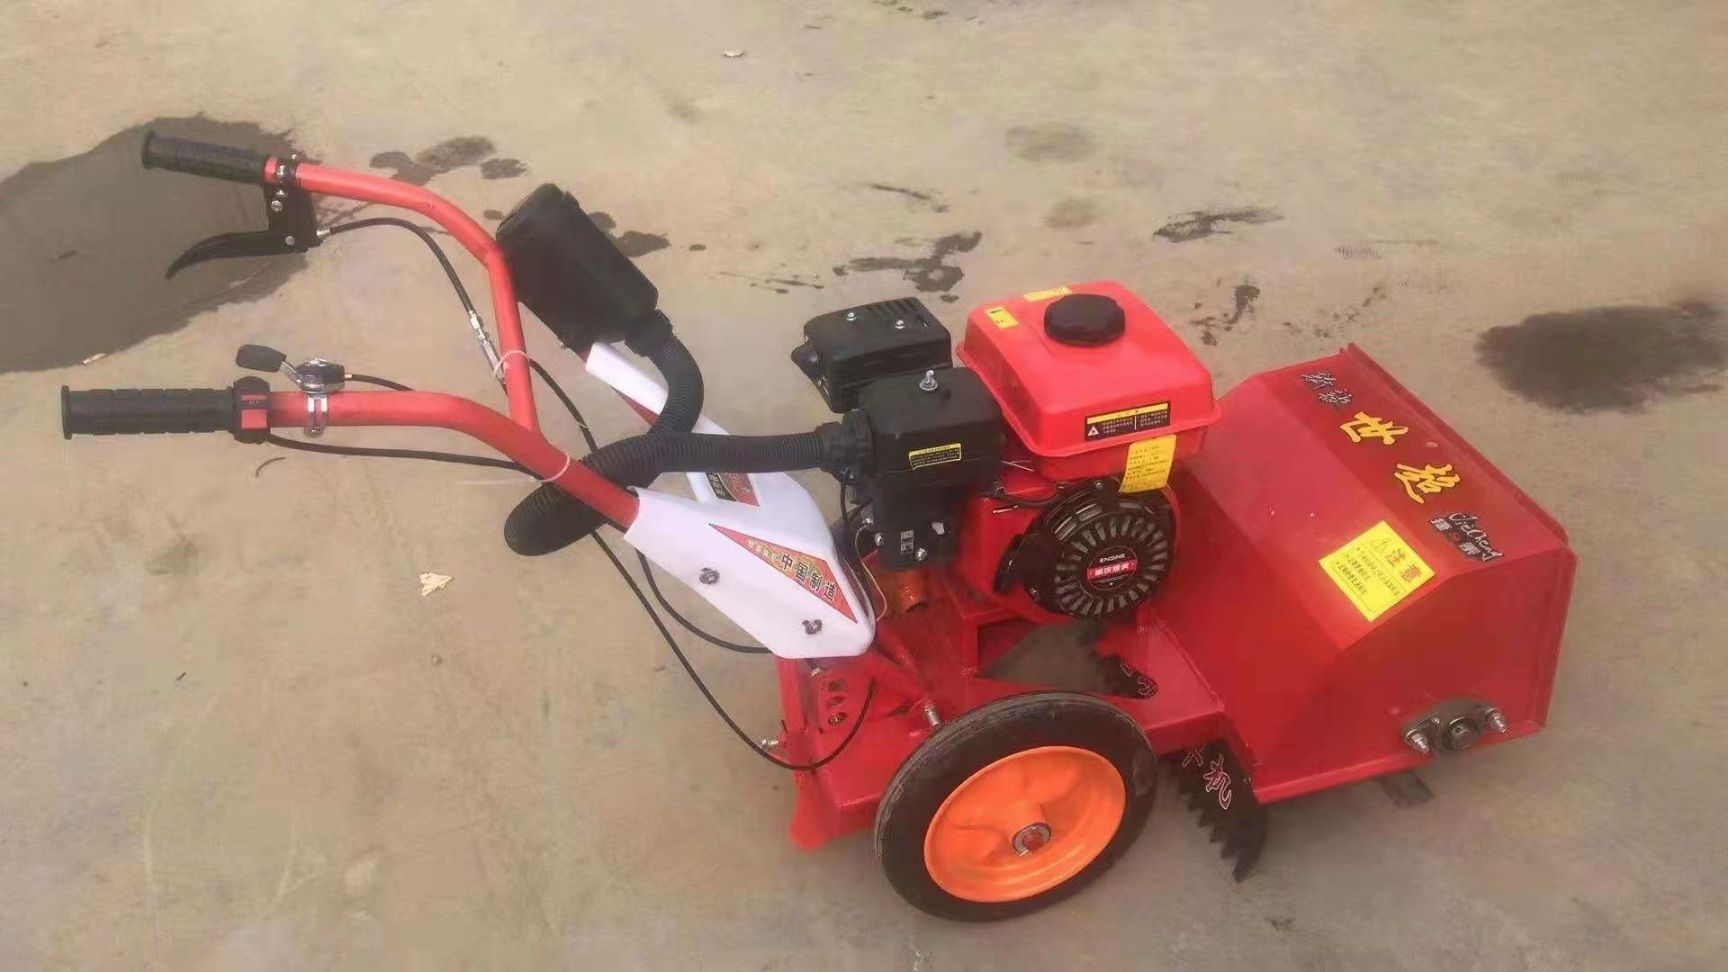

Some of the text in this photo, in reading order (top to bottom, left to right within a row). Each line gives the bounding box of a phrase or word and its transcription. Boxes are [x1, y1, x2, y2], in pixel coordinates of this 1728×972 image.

[781, 551, 837, 602] 中国制造
[1099, 553, 1126, 563] ENGINE
[1384, 547, 1423, 584] 注意
